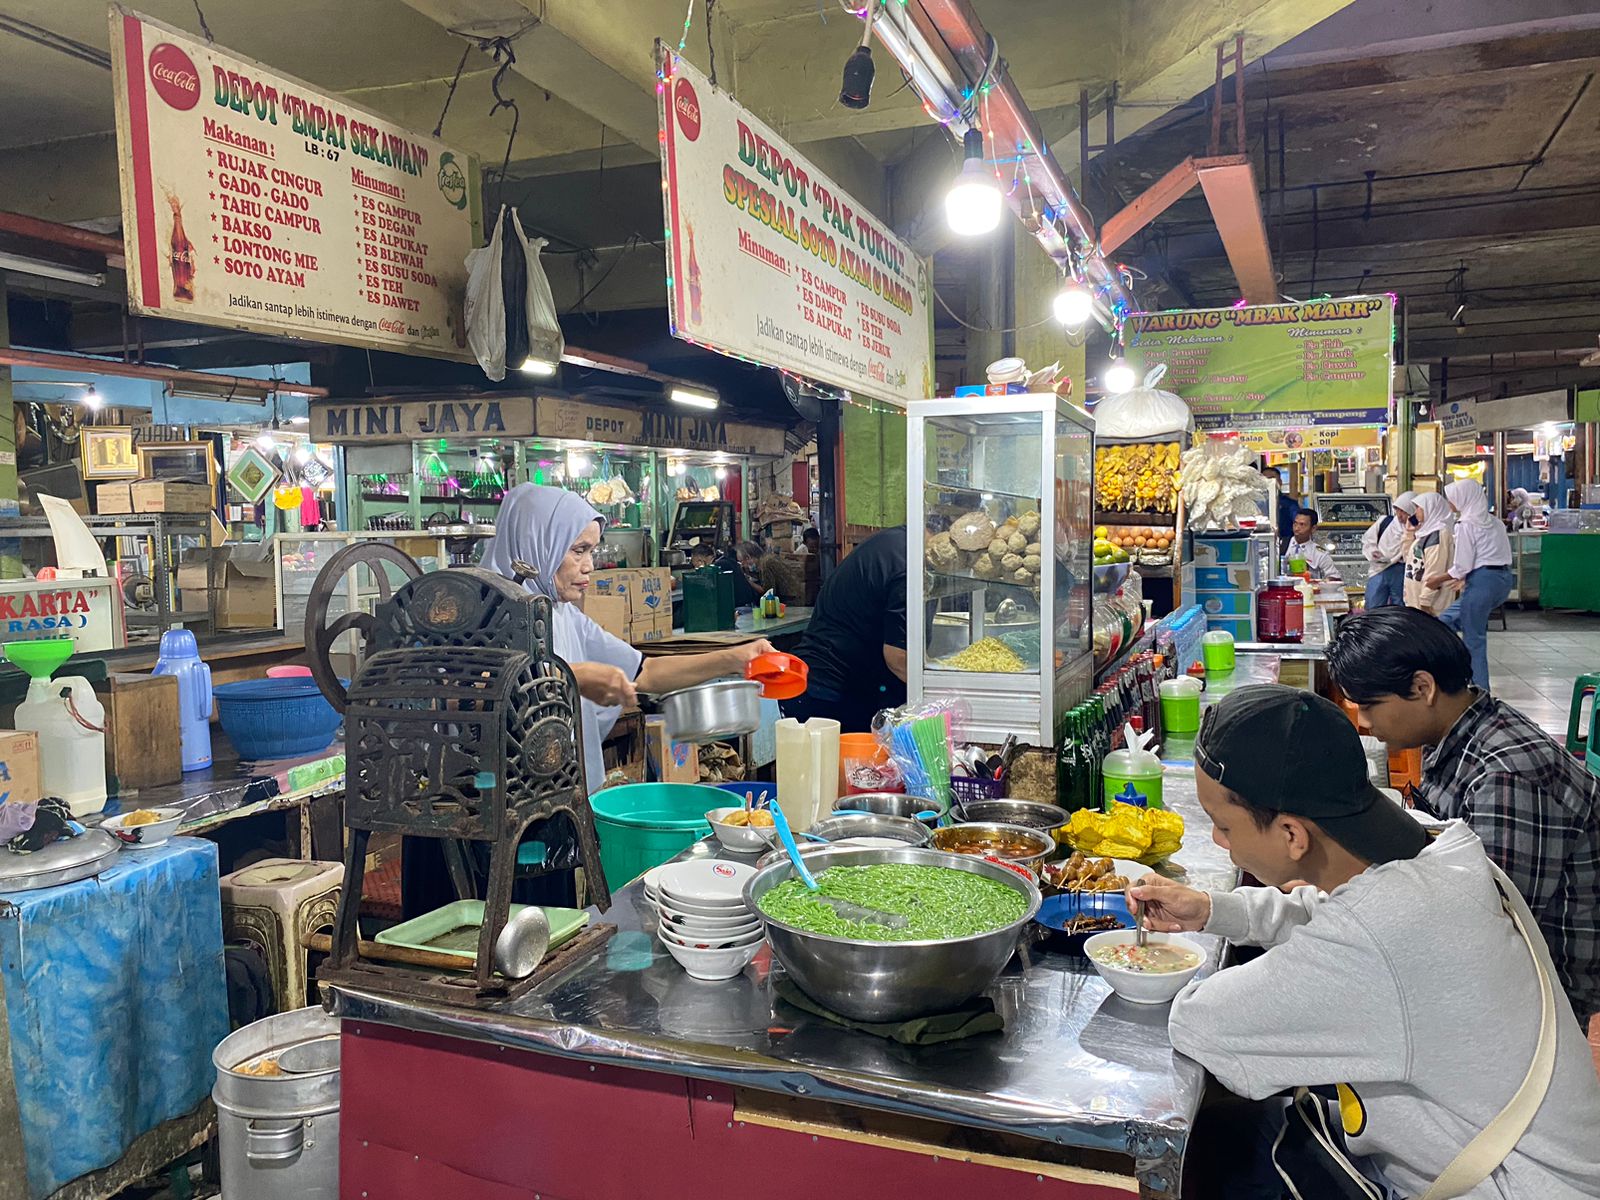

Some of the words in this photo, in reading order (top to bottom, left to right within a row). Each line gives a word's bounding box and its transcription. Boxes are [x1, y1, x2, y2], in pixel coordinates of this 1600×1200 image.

[203, 116, 267, 155] Makanan
[213, 64, 278, 125] DEPOT
[350, 119, 428, 178] SEKAWAN"
[305, 141, 319, 154] LB
[327, 150, 339, 162] 67
[737, 119, 809, 207] DEPOT
[217, 151, 268, 181] RUJAK
[271, 168, 323, 197] CINGUR
[351, 166, 400, 198] Minuman
[219, 173, 261, 198] GADO
[271, 188, 309, 212] GADO
[220, 194, 261, 218] TAHU
[265, 206, 321, 234] CAMPUR
[361, 195, 375, 210] ES
[377, 202, 422, 225] CAMPUR
[362, 211, 376, 226] ES
[378, 217, 415, 237] DEGAN
[221, 215, 272, 241] BAKSO
[363, 228, 377, 241] ES
[379, 233, 428, 256] ALPUKAT
[723, 163, 799, 245] SPESIAL
[800, 216, 838, 268] SOTO
[839, 243, 872, 291] AYAM
[223, 236, 291, 265] LONTONG
[295, 252, 319, 271] MIE
[364, 243, 378, 257] ES
[380, 248, 424, 269] BLEWAH
[738, 228, 786, 272] Minuman
[225, 257, 263, 280] SOTO
[267, 266, 305, 288] AYAM
[365, 259, 379, 273] ES
[381, 264, 409, 280] SUSU
[411, 271, 438, 287] SODA
[366, 275, 380, 288] ES
[381, 279, 403, 294] TEH
[801, 268, 813, 285] ES
[814, 276, 847, 305] CAMPUR
[229, 294, 263, 310] Jadikan
[265, 304, 293, 316] santap
[295, 305, 315, 319] lebih
[316, 308, 350, 324] istimewa
[351, 316, 377, 331] dengan
[407, 325, 419, 337] dan
[367, 291, 380, 304] ES
[383, 295, 420, 312] DAWET
[803, 287, 814, 304] ES
[815, 294, 843, 320] DAWET
[861, 302, 869, 317] ES
[757, 314, 784, 342] Jadikan
[785, 330, 808, 354] santap
[809, 335, 824, 358] lebih
[803, 305, 815, 322] ES
[816, 311, 852, 340] ALPUKAT
[861, 319, 870, 333] ES
[1132, 311, 1221, 334] WARUNG
[1287, 327, 1352, 338] Minuman
[327, 406, 402, 436] MINI
[418, 402, 506, 433] JAYA
[586, 416, 624, 434] DEPOT
[641, 411, 683, 441] MINI
[688, 417, 728, 444] JAYA
[8, 615, 73, 633] RASA
